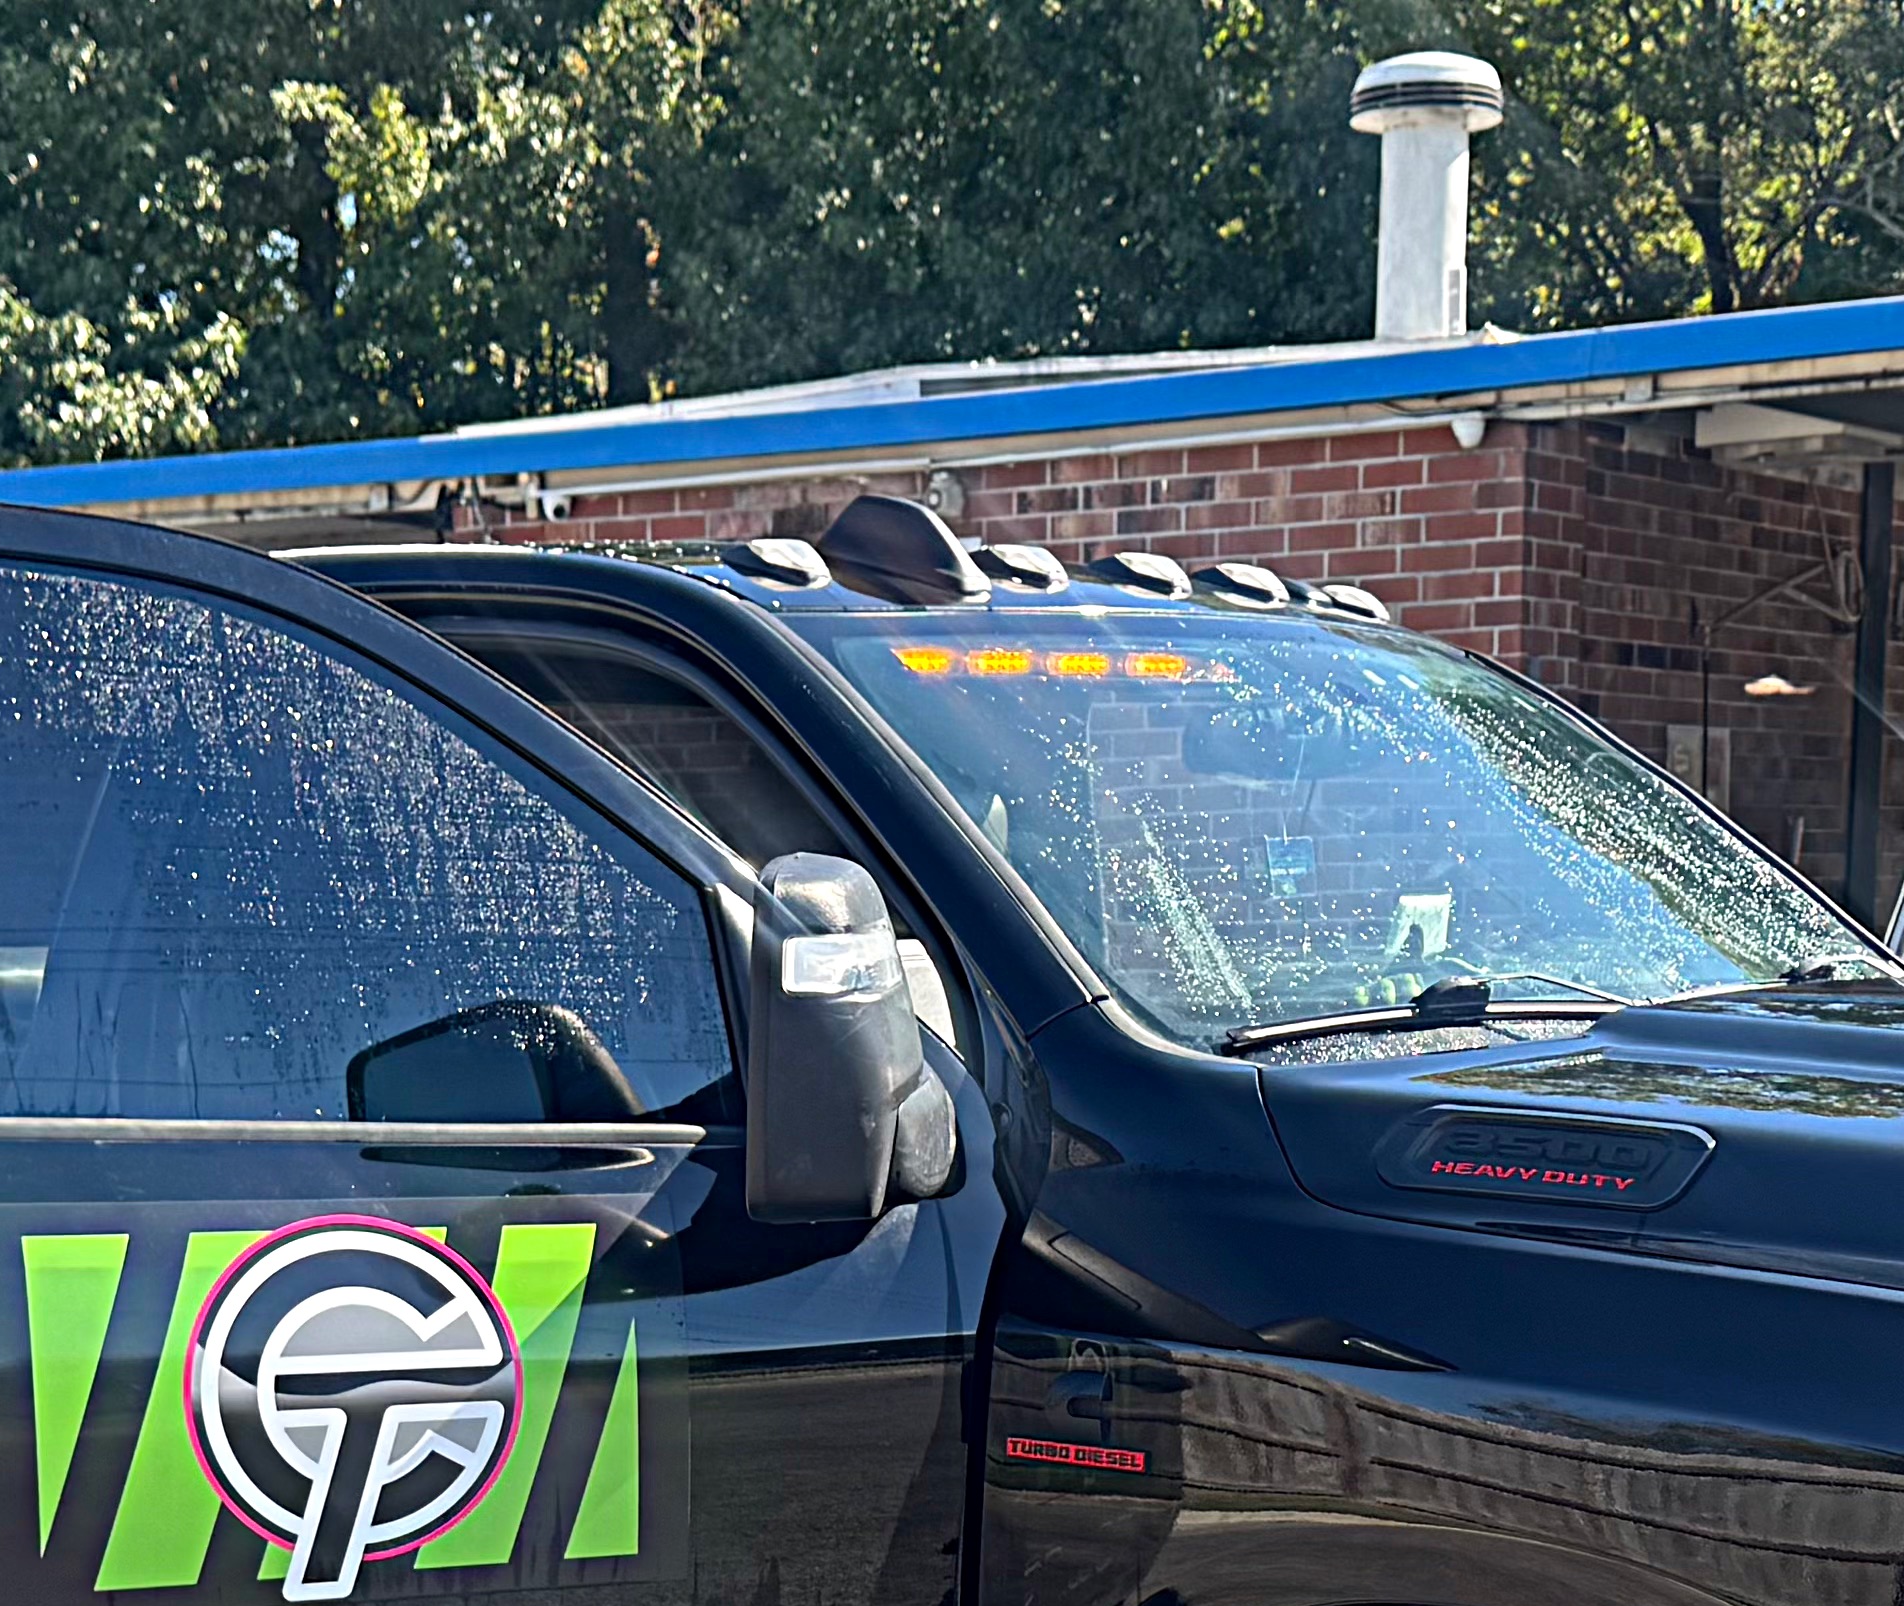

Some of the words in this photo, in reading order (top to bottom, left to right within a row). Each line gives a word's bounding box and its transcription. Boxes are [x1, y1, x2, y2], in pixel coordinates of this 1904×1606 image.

[1431, 1161, 1538, 1181] HEAVY
[1542, 1170, 1634, 1190] DUTY
[1008, 1439, 1070, 1460] TURBO
[1074, 1448, 1142, 1469] DIESEL
